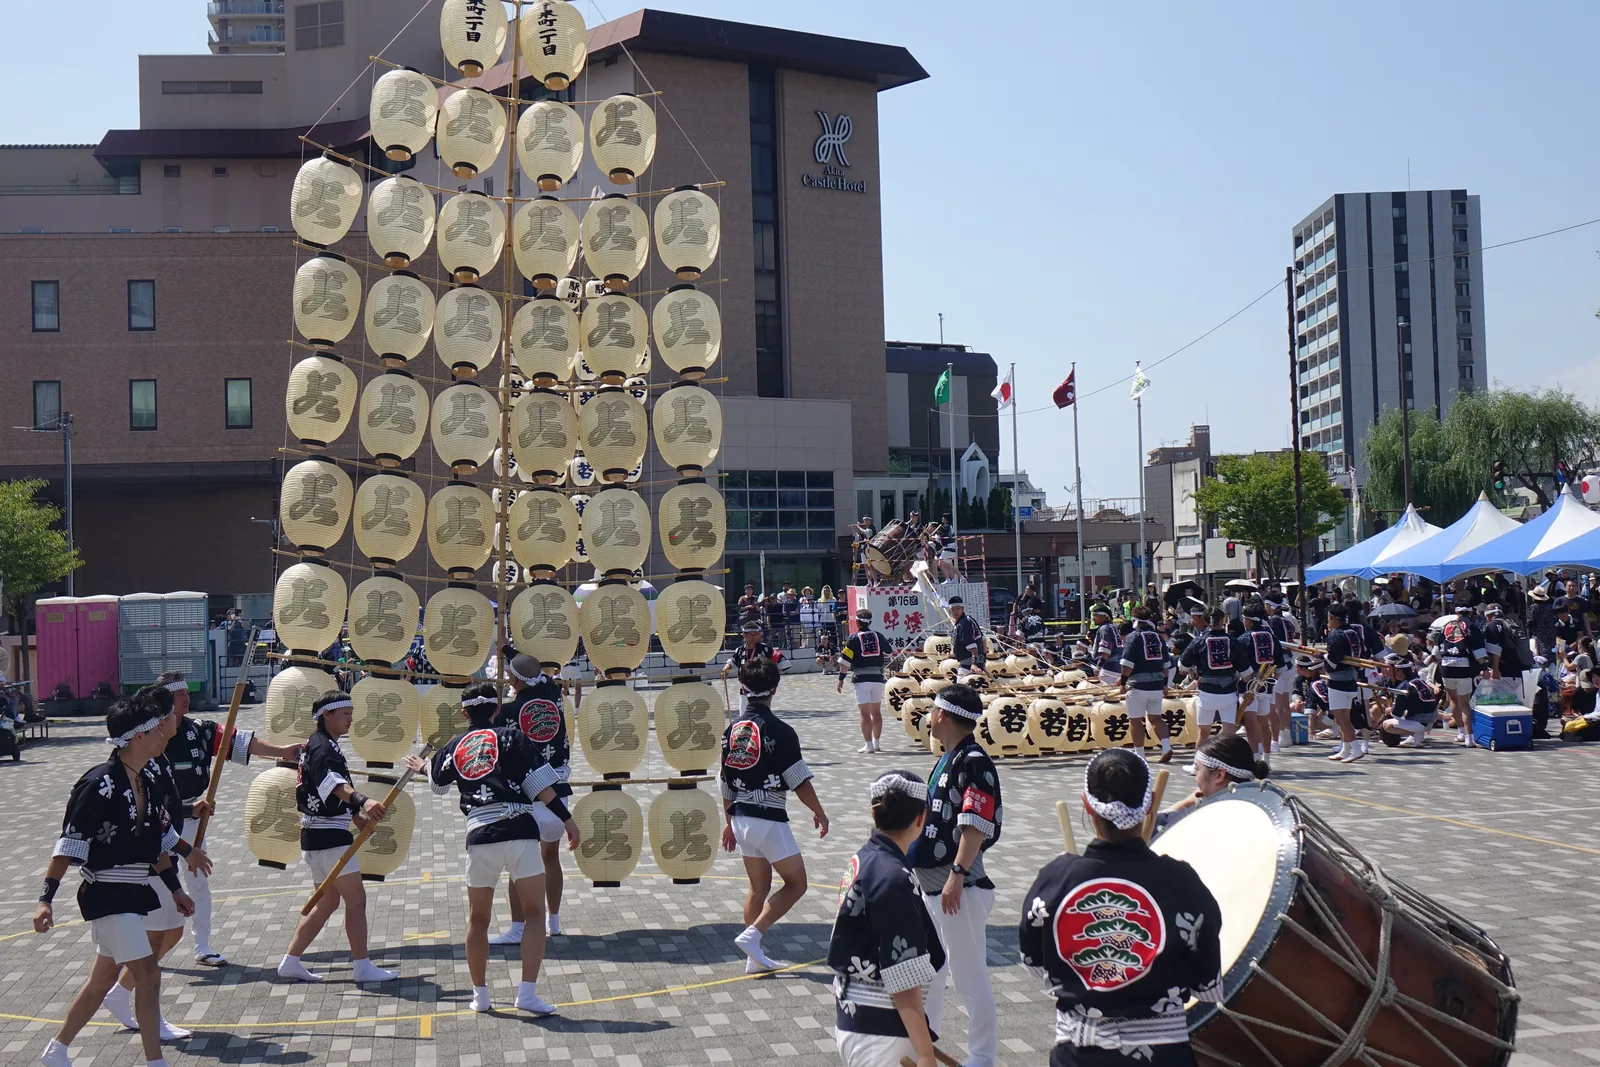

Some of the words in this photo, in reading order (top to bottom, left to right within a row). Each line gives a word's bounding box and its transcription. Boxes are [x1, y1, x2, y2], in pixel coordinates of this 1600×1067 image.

[802, 174, 836, 189] Castle
[837, 177, 866, 193] Hotel
[824, 166, 845, 176] Akita
[888, 595, 919, 607] 第76回
[999, 703, 1027, 734] 若
[1039, 707, 1067, 737] 若
[1104, 713, 1130, 742] 若
[185, 730, 203, 776] 秋田市
[925, 772, 949, 839] 秋田市
